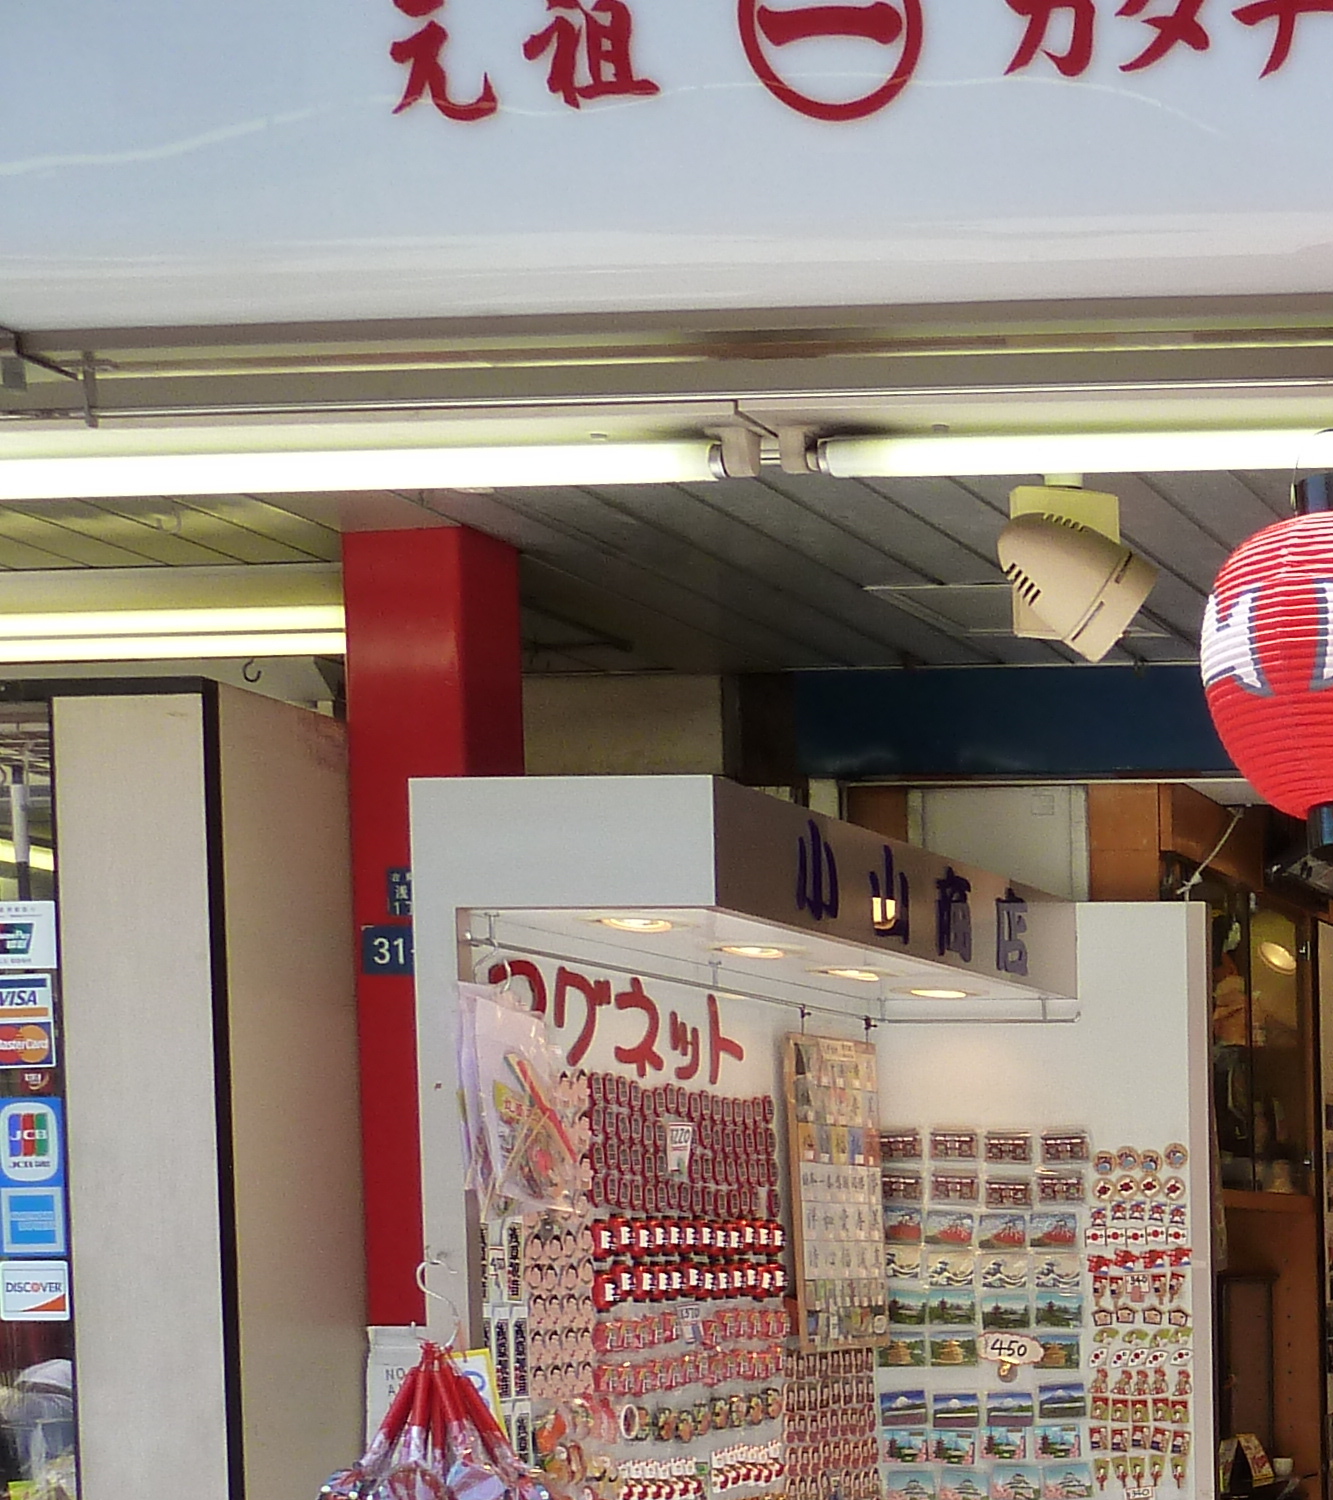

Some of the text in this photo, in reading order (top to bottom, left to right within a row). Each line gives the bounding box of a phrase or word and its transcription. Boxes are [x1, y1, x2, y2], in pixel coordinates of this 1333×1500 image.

[10, 1130, 48, 1140] JCB
[6, 1282, 63, 1293] DISCOVER
[991, 1339, 1028, 1358] 450
